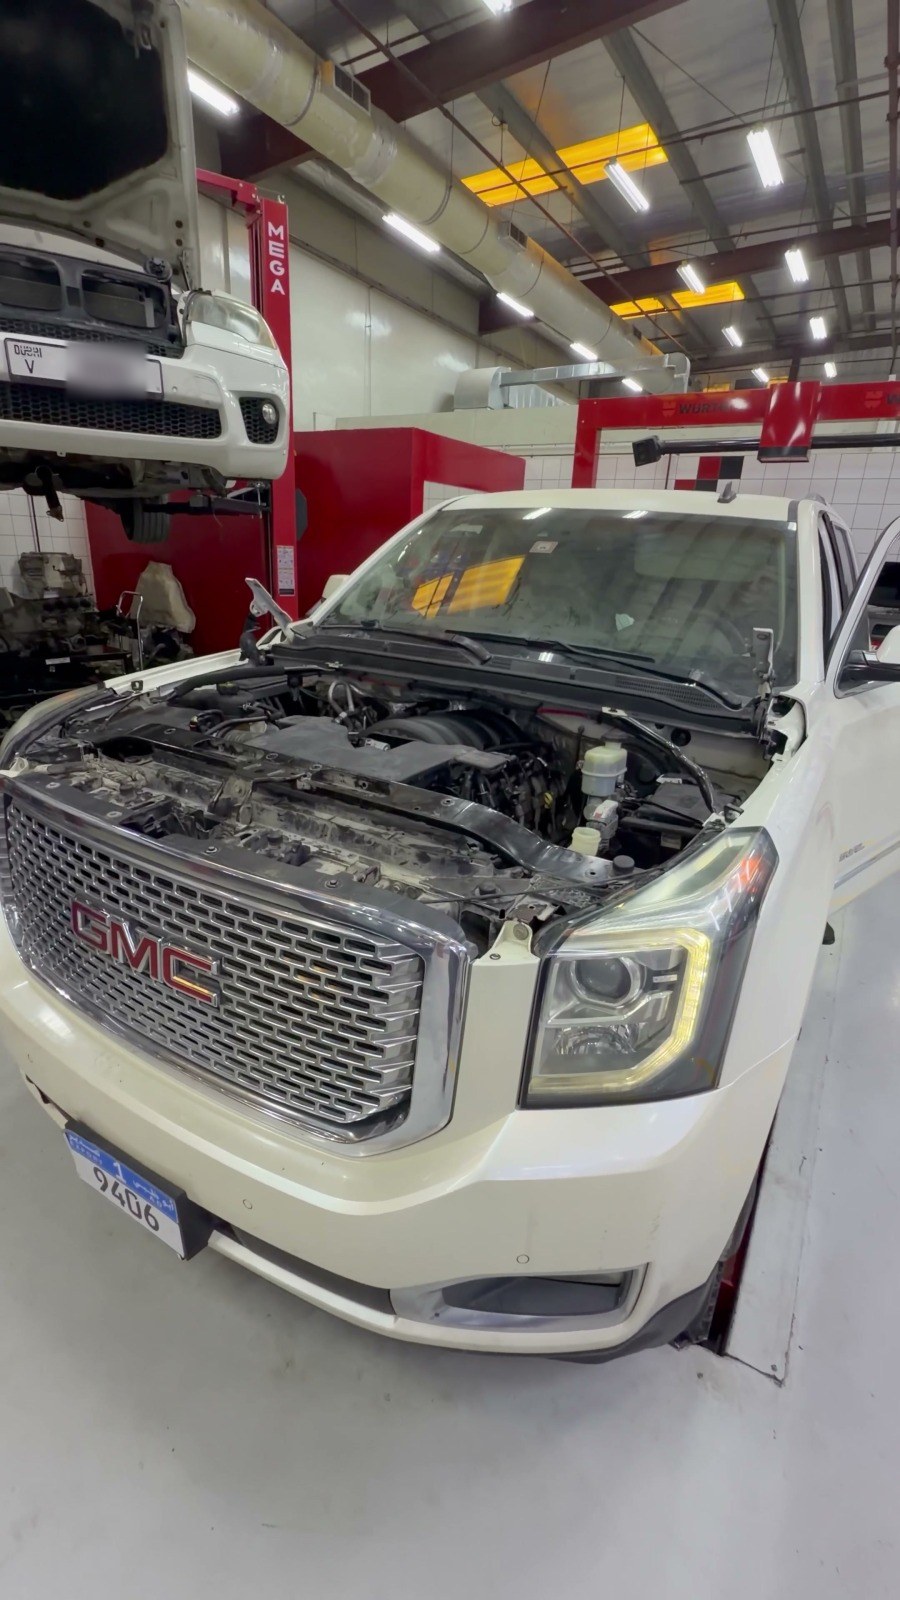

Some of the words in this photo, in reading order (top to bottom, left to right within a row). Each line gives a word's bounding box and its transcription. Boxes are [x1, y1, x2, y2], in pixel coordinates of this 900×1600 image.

[268, 221, 285, 295] MEGA
[25, 358, 34, 374] V
[70, 898, 218, 1008] GMC
[93, 1166, 160, 1232] 9406
